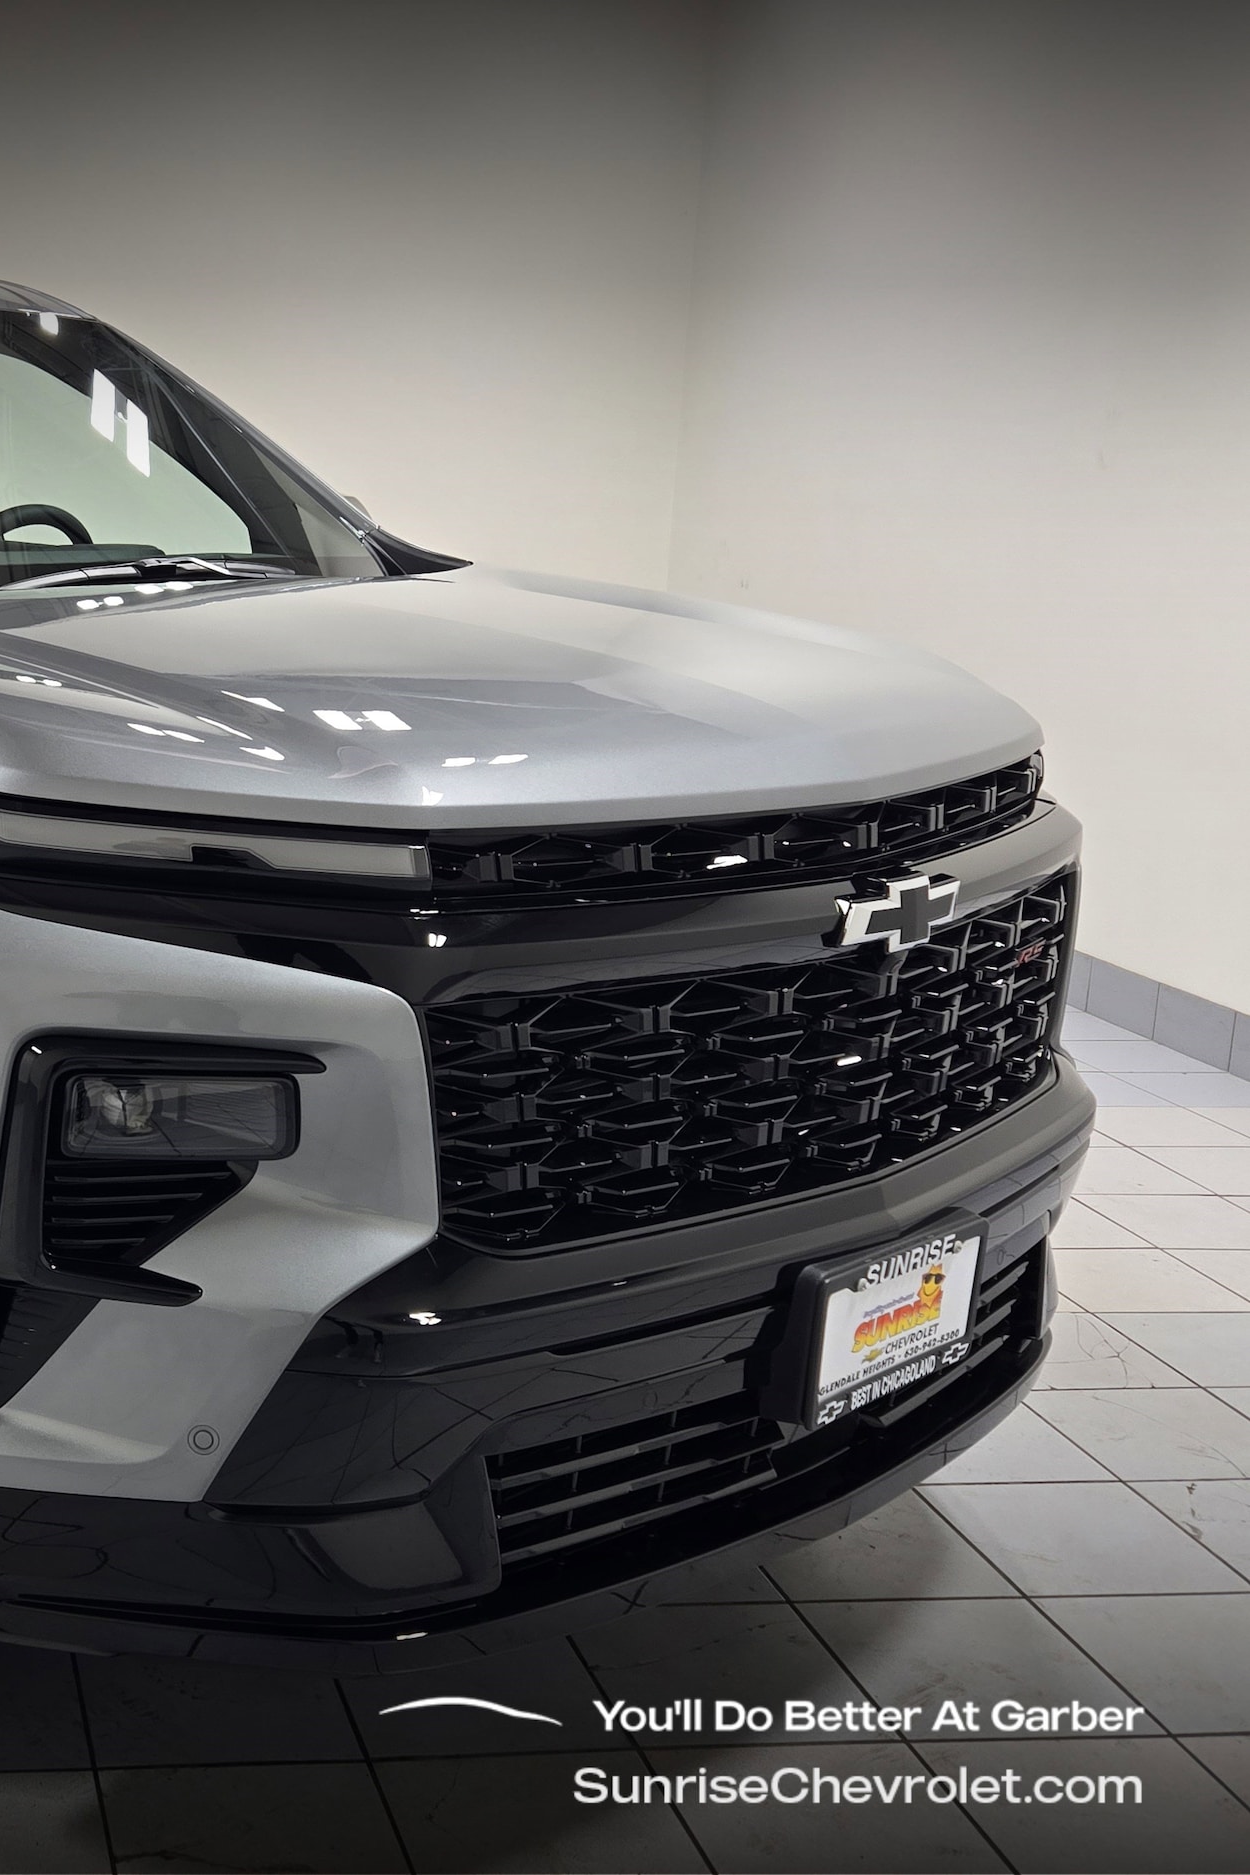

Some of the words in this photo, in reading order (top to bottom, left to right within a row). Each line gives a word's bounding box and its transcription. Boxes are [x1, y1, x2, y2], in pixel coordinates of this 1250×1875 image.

[867, 1233, 956, 1289] SUNRISE
[851, 1300, 942, 1354] SUNRISE
[885, 1323, 939, 1355] CHEVROLET
[819, 1370, 861, 1395] GLENDALE
[862, 1356, 896, 1377] HEIGHTS
[851, 1383, 872, 1411] BEST
[872, 1380, 882, 1401] IN
[881, 1354, 936, 1396] CHICAGOLAND
